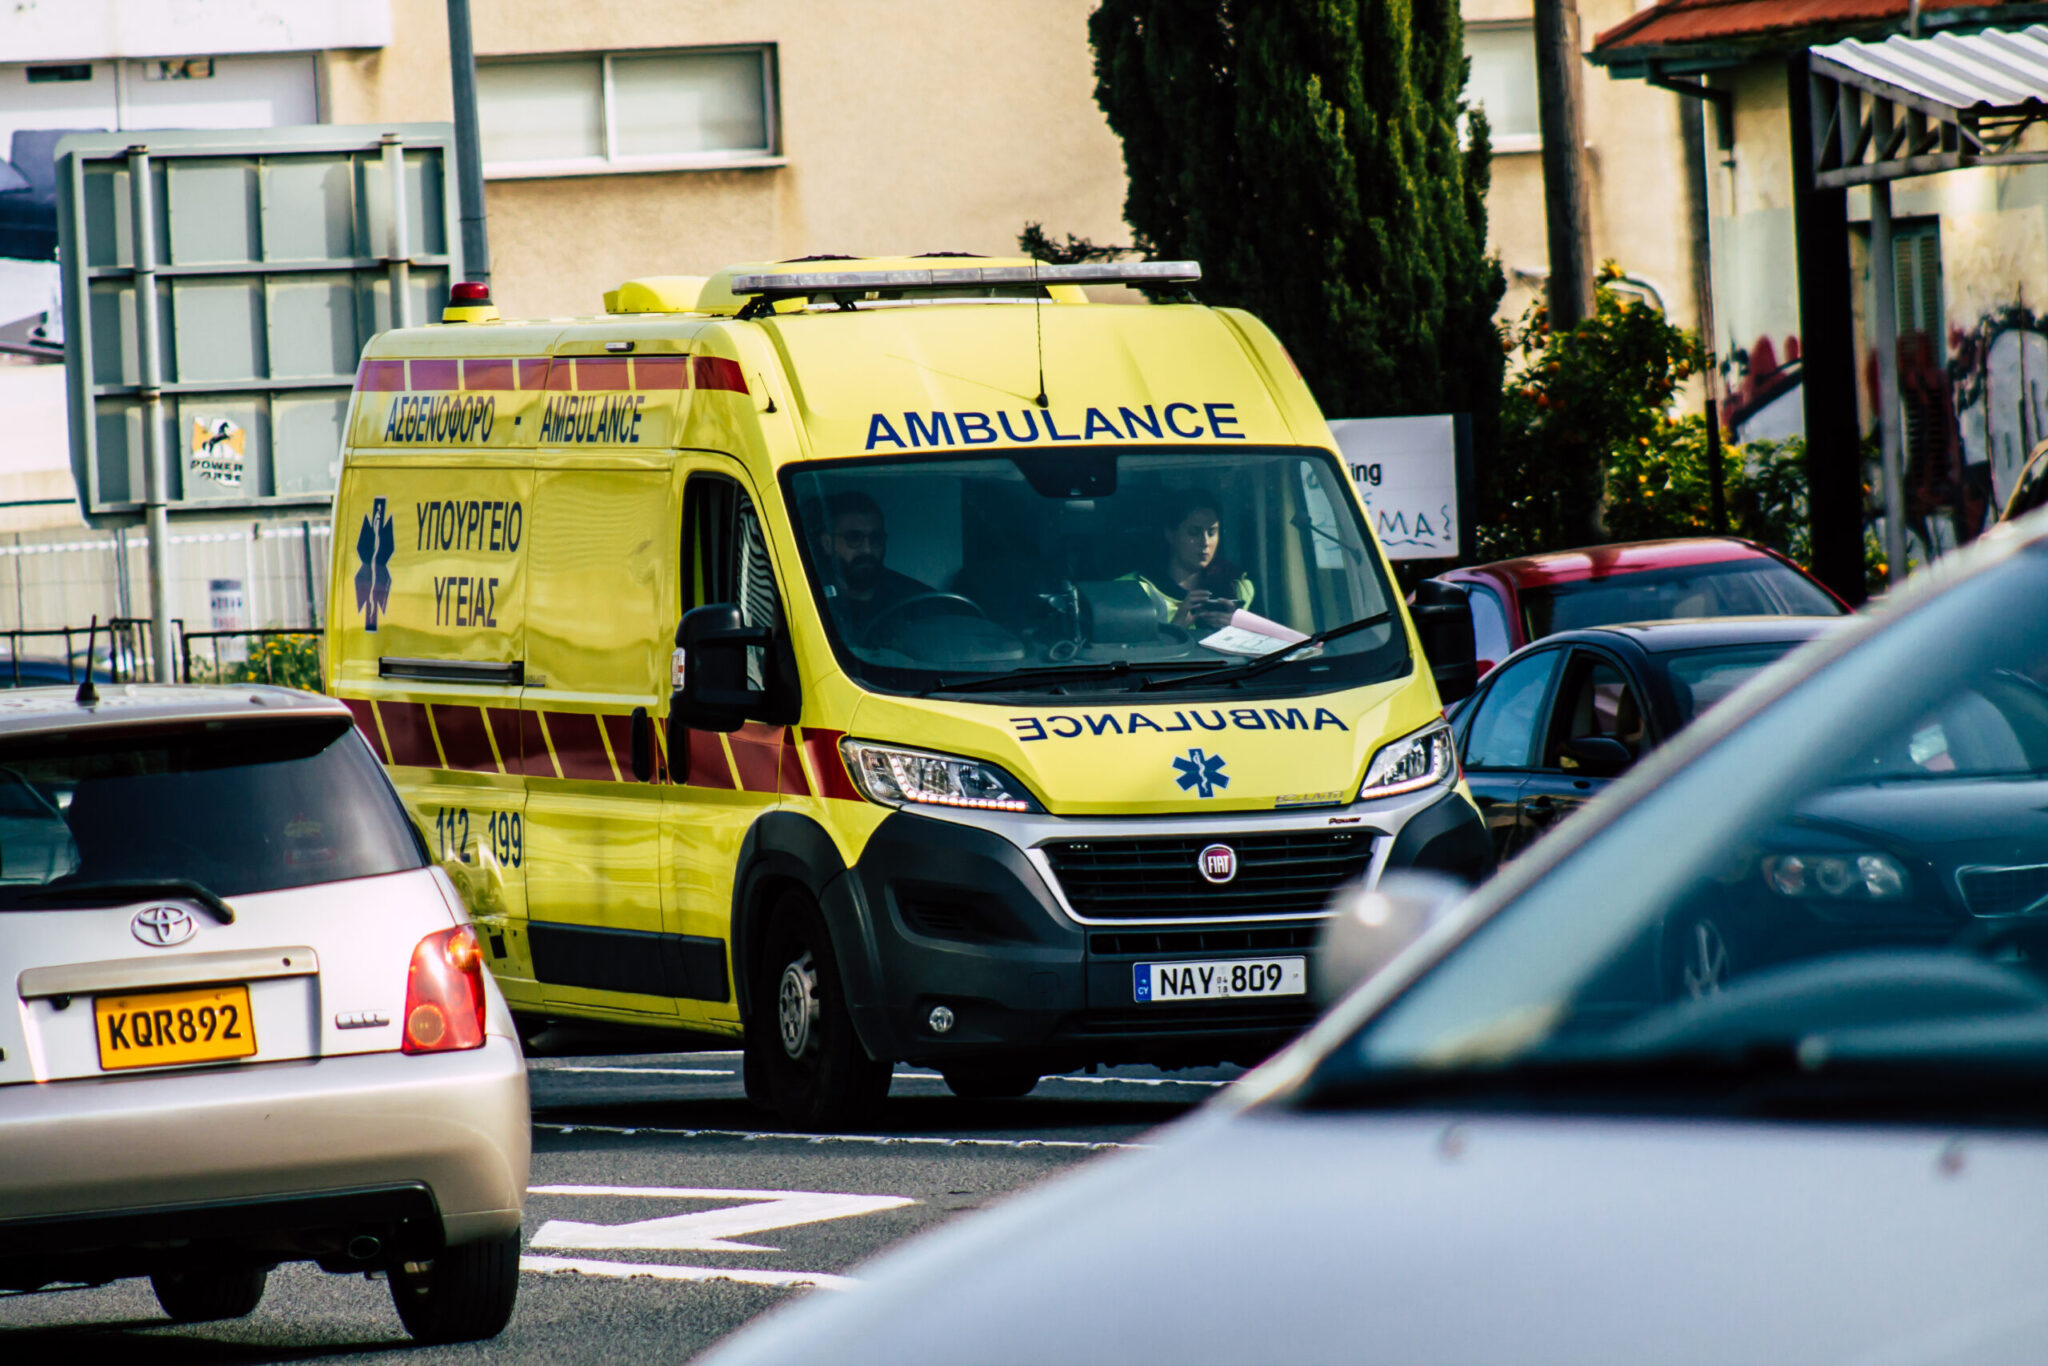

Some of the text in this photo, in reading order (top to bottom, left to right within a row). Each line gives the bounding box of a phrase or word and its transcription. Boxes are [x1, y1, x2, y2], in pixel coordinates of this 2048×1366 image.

[384, 394, 496, 444] ΑΣΘΕΝΟΦΟΡΟ
[538, 394, 646, 444] AMBULANCE
[864, 402, 1247, 451] AMBULANCE
[190, 459, 244, 472] POWER
[1350, 462, 1383, 487] ing
[416, 500, 523, 553] ΥΠΟΥΡΓΕΙΟ
[433, 576, 499, 628] ΥΓΕΙΑΣ
[436, 806, 522, 869] 112 199
[1207, 855, 1229, 874] FIAT
[1137, 986, 1150, 996] CY
[1160, 963, 1282, 996] NAY 809
[107, 1004, 242, 1051] KQR892
